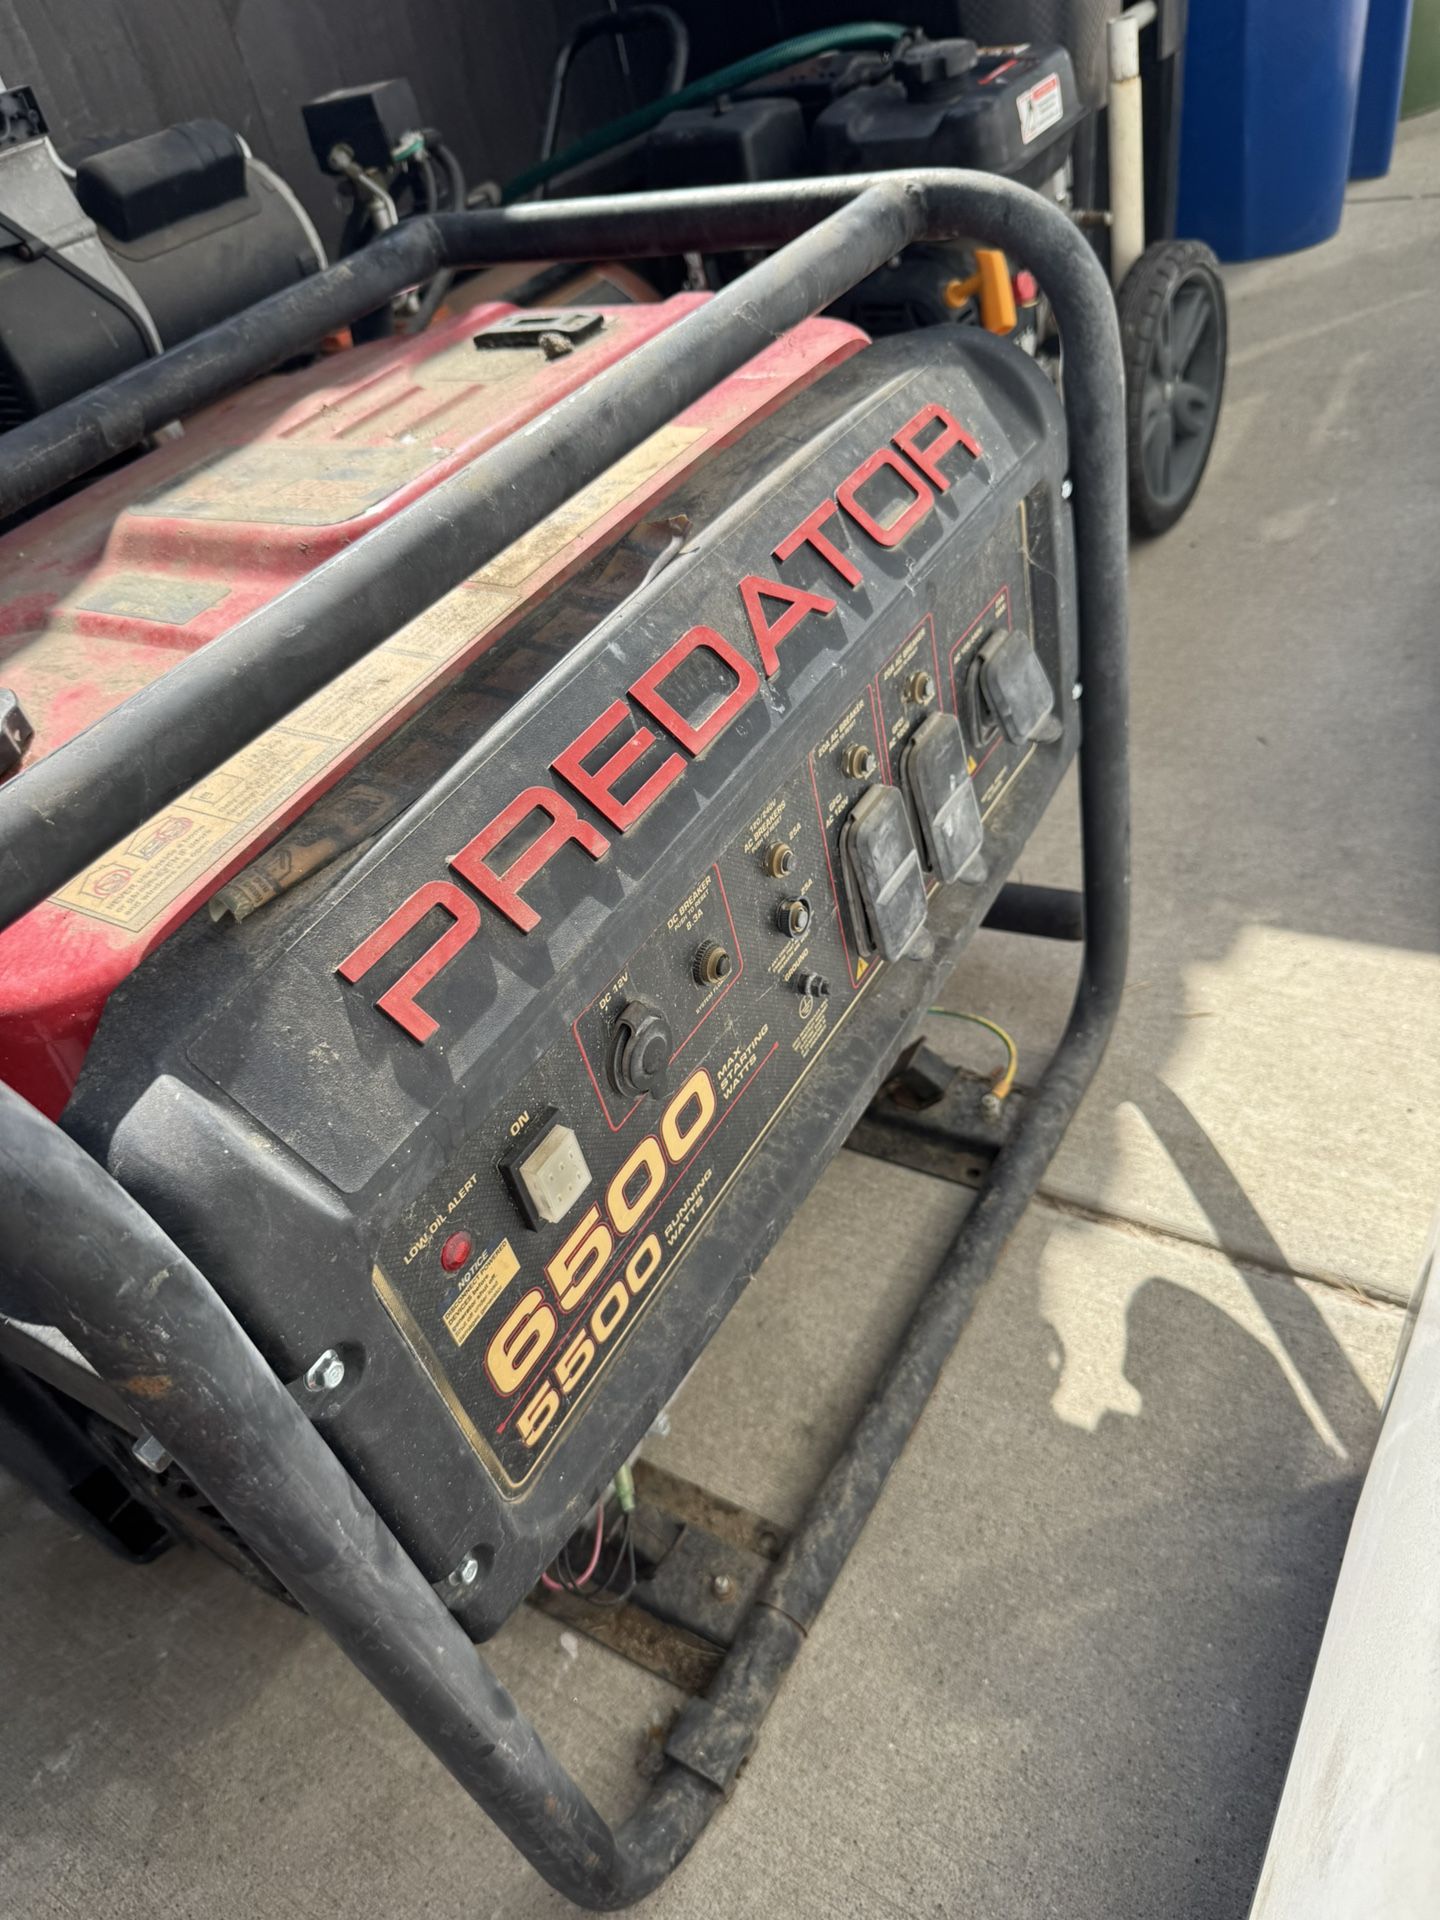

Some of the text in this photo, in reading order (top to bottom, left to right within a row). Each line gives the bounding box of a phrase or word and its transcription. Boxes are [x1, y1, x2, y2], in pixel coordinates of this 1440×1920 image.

[335, 404, 983, 1044] PREDATOR
[744, 799, 786, 854] AC BREAKERS
[667, 875, 712, 930] DC BREAKER
[686, 908, 704, 931] 8.3A
[599, 971, 630, 1010] DC 12V
[784, 947, 809, 982] GROUND
[716, 1046, 741, 1081] MAX
[720, 1023, 770, 1092] STARTING
[723, 1053, 757, 1100] WATTS
[509, 1110, 531, 1137] ON
[403, 1173, 478, 1265] LOW OIL ALERT
[664, 1168, 713, 1238] RUNNING
[667, 1195, 705, 1247] WATTS
[483, 1066, 717, 1398] 6500
[444, 1239, 507, 1320] DISCONNECT POWERED
[457, 1248, 489, 1291] NOTICE
[447, 1293, 472, 1326] DEVICES
[516, 1232, 662, 1449] 5500
